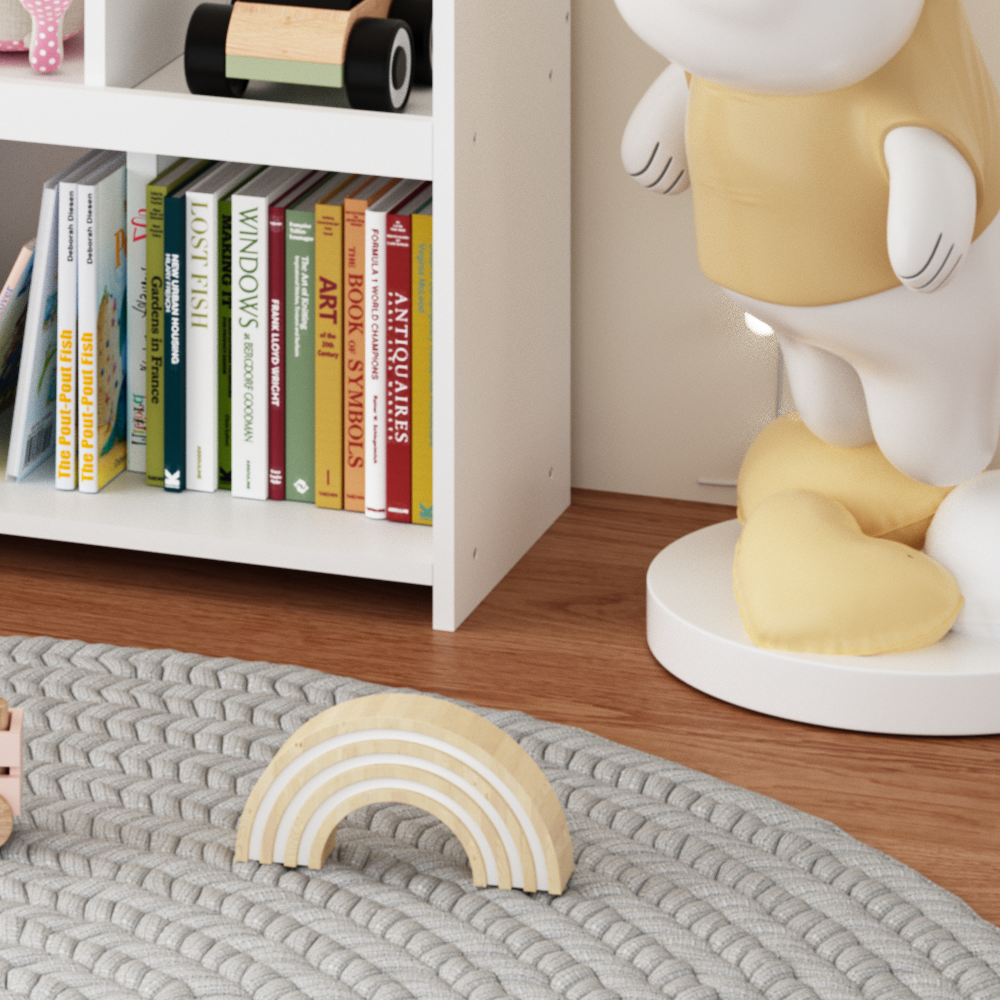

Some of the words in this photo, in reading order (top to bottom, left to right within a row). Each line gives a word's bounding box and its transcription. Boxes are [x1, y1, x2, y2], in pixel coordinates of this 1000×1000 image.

[191, 202, 208, 267] LOST
[222, 214, 232, 286] MAKING
[371, 228, 379, 275] FORMULA
[170, 253, 180, 279] NEW
[239, 207, 259, 328] WINDOWS
[300, 256, 309, 272] The
[348, 246, 356, 269] THE
[416, 243, 426, 276] Virginia
[170, 279, 180, 316] URBAN
[191, 273, 208, 329] FISH
[300, 273, 309, 287] Art
[300, 287, 309, 297] of
[319, 276, 337, 325] ART
[151, 276, 163, 334] Gardens
[271, 299, 281, 331] FRANK
[299, 297, 309, 331] Knitting
[348, 273, 364, 335] BOOK
[371, 286, 379, 321] WORLD
[60, 329, 73, 362] Fish
[81, 332, 94, 365] Fish
[151, 337, 162, 352] in
[170, 317, 180, 365] HOUSING
[271, 332, 281, 365] LLOYD
[348, 340, 356, 355] OF
[371, 323, 379, 380] CHAMPIONS
[151, 356, 162, 404] France
[244, 342, 254, 390] BERGDORF
[271, 366, 281, 408] WRIGHT
[392, 292, 409, 443] ANTIQUAIRES
[59, 366, 72, 446] Pout-Pout
[81, 369, 94, 449] Pout-Pout
[244, 392, 254, 443] GOODMAN
[348, 359, 364, 468] SYMBOLS
[58, 449, 71, 479] The
[81, 452, 94, 481] The
